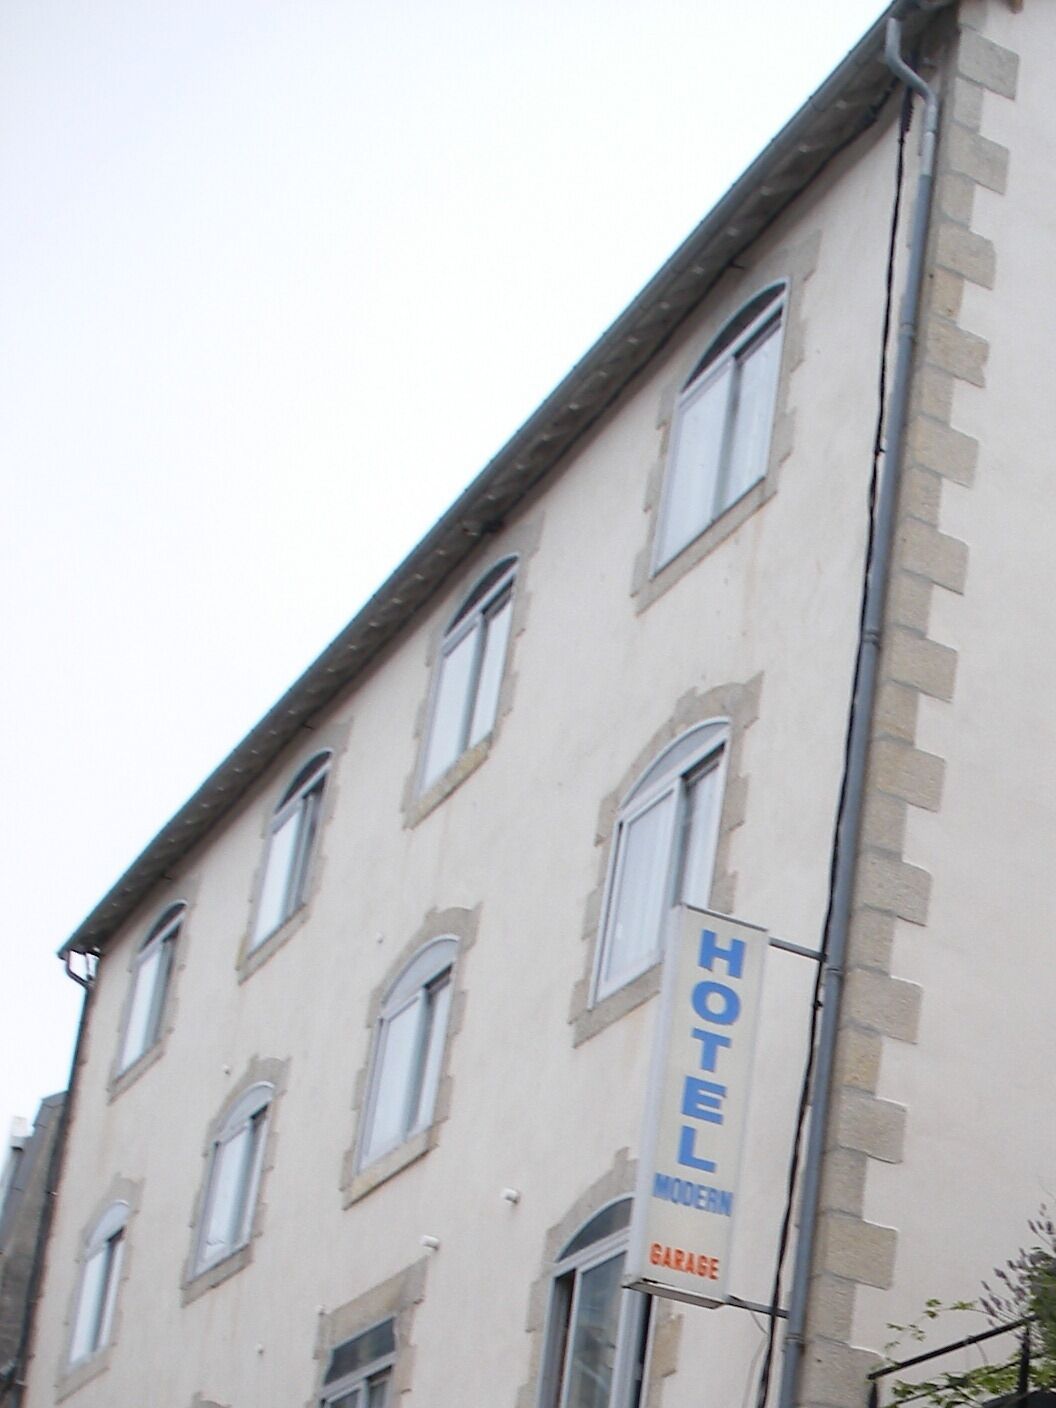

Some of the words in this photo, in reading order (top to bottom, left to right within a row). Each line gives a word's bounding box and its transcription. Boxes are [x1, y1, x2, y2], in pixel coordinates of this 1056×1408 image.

[678, 929, 746, 1173] HOTEL
[653, 1173, 732, 1217] MODERN
[649, 1242, 719, 1280] GARAGE
